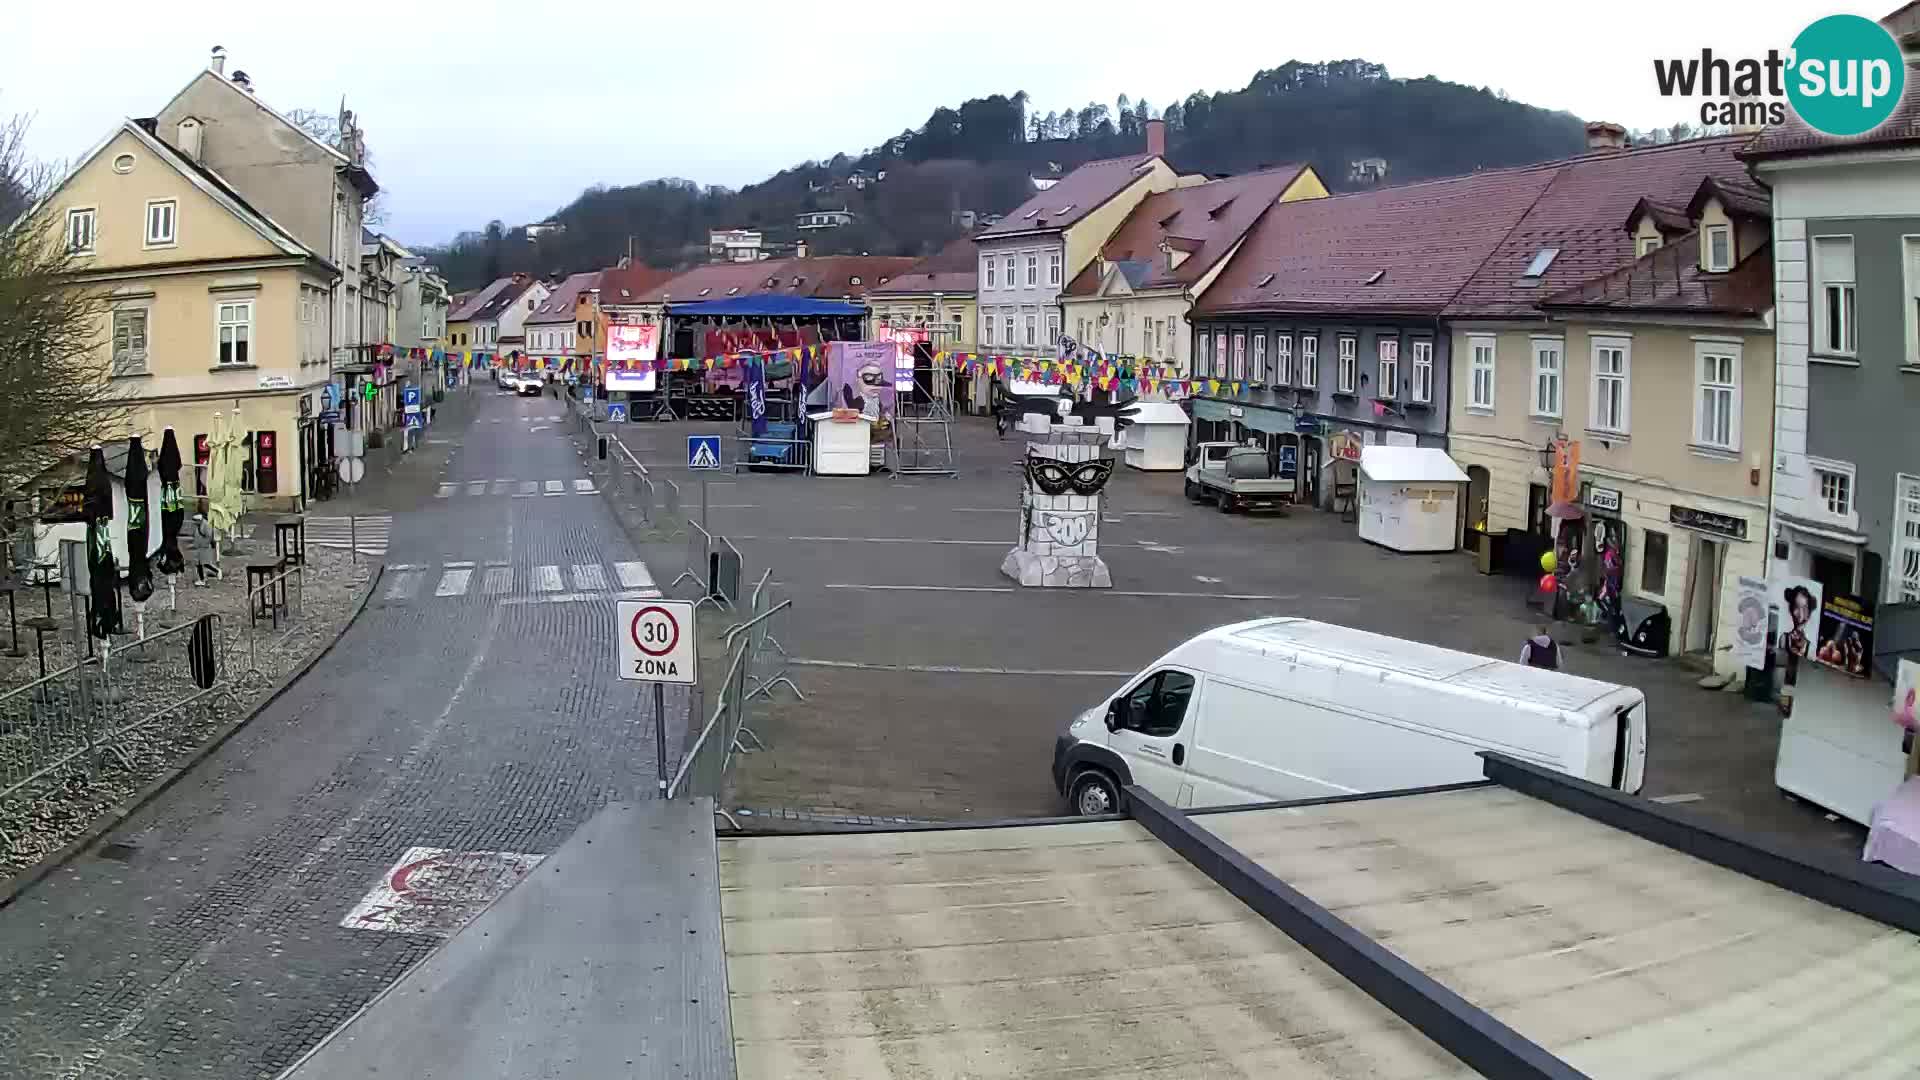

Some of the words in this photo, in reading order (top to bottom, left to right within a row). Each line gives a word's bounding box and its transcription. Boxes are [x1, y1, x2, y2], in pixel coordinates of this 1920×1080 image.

[408, 391, 416, 402] P
[643, 623, 667, 643] 30
[633, 660, 679, 677] ZONA
